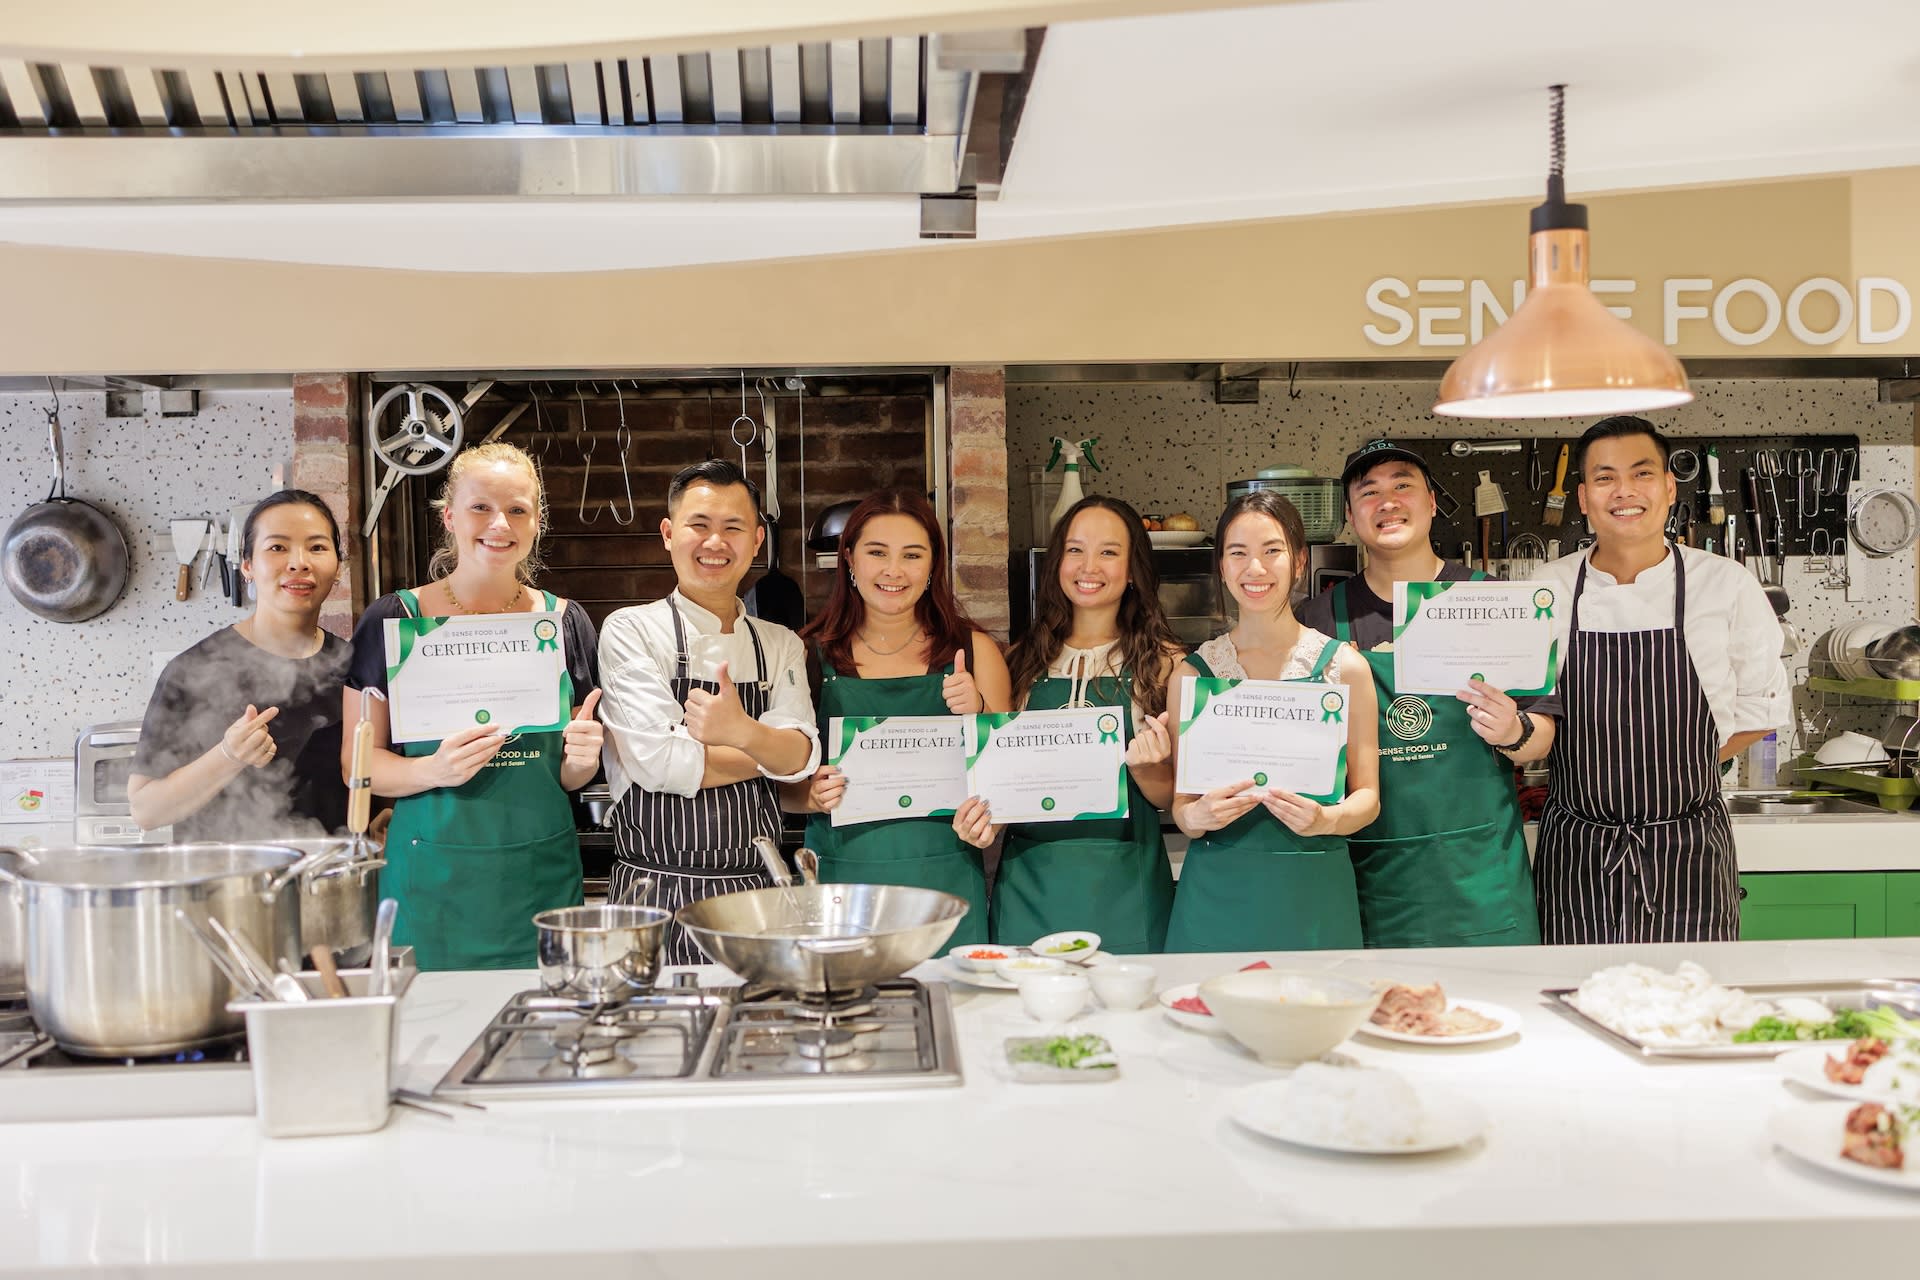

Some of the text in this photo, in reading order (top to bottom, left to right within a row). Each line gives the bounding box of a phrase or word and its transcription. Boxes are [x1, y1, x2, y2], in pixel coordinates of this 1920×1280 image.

[1362, 277, 1912, 346] SENE FOOD
[1425, 607, 1528, 620] CERTIFICATE
[421, 640, 531, 657] CERTIFICATE
[1213, 703, 1316, 721] CERTIFICATE
[860, 737, 956, 750] CERTIFICATE
[996, 732, 1094, 748] CERTIFICATE
[496, 750, 541, 759] FOOD LAB
[1378, 743, 1448, 756] SENSE FOOD LAB
